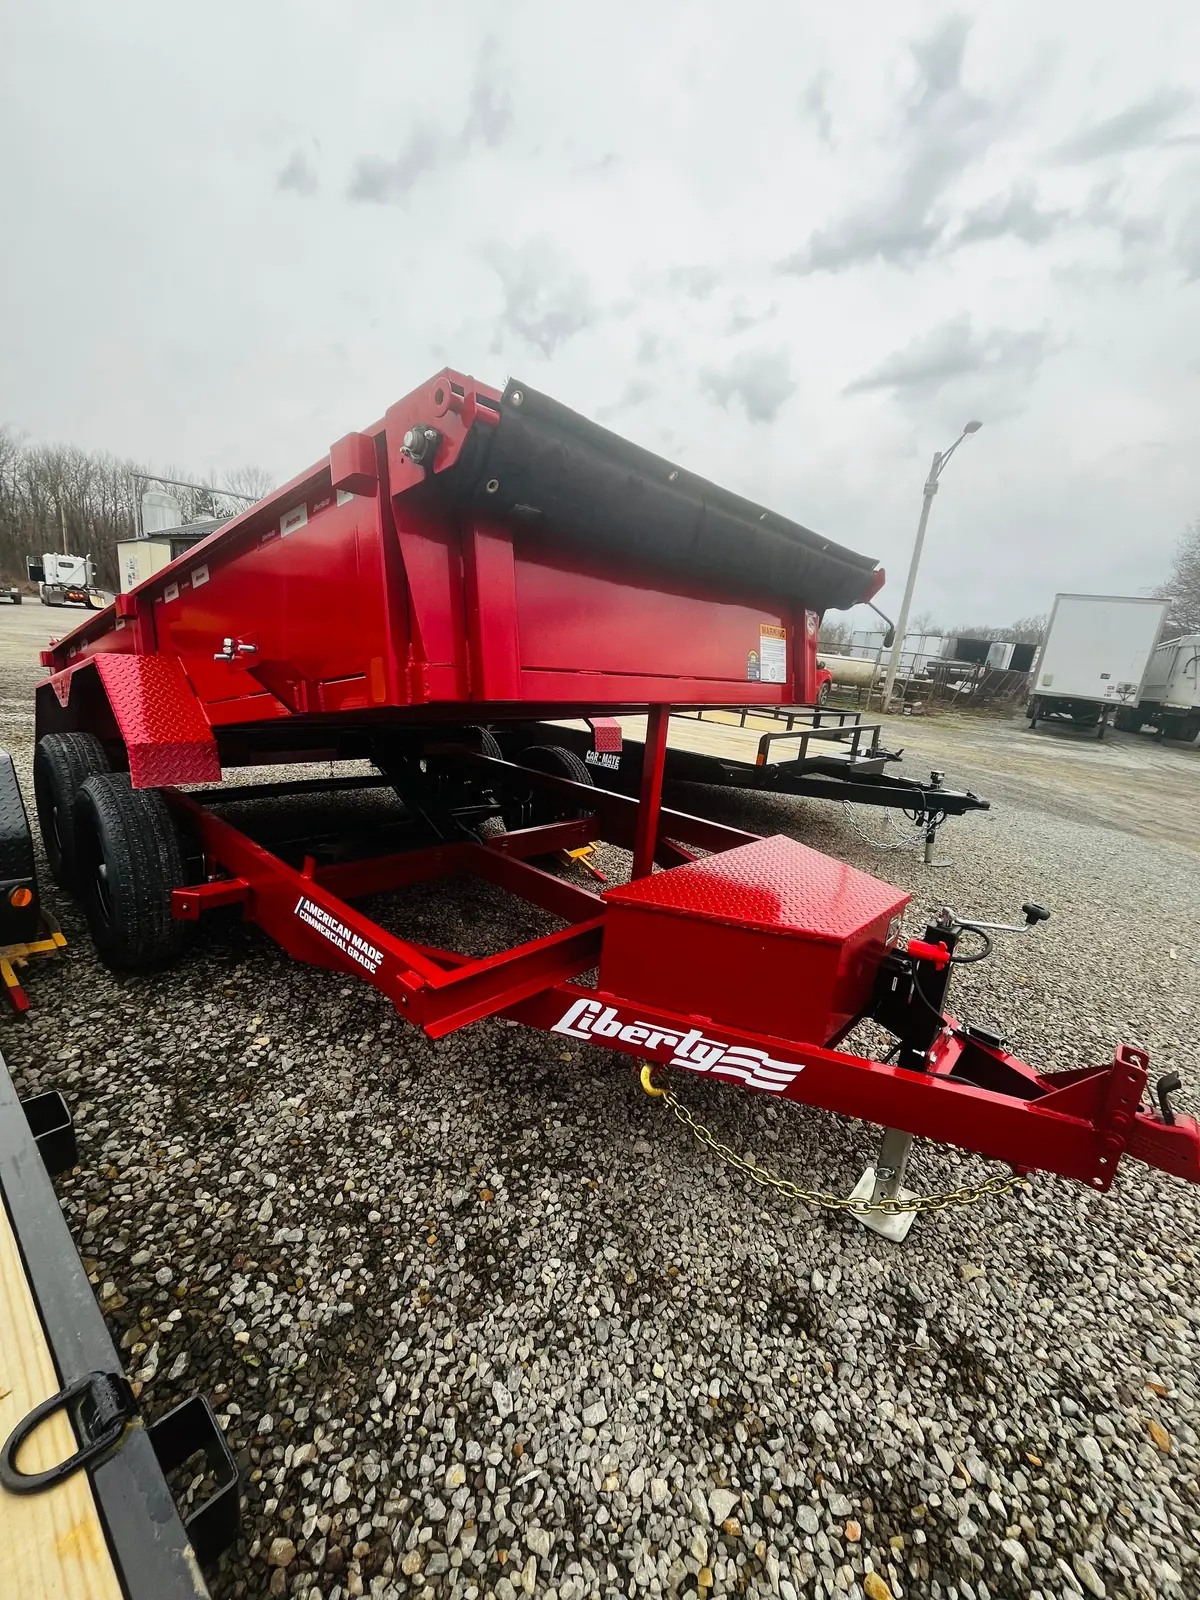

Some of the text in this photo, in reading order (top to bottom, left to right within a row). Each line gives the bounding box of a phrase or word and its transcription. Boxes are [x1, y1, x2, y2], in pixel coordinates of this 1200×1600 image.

[761, 625, 785, 638] WARNING
[299, 909, 377, 974] COMMERCIAL GRADE
[303, 899, 384, 966] AMERICAN MADE
[550, 998, 729, 1072] Liberty
